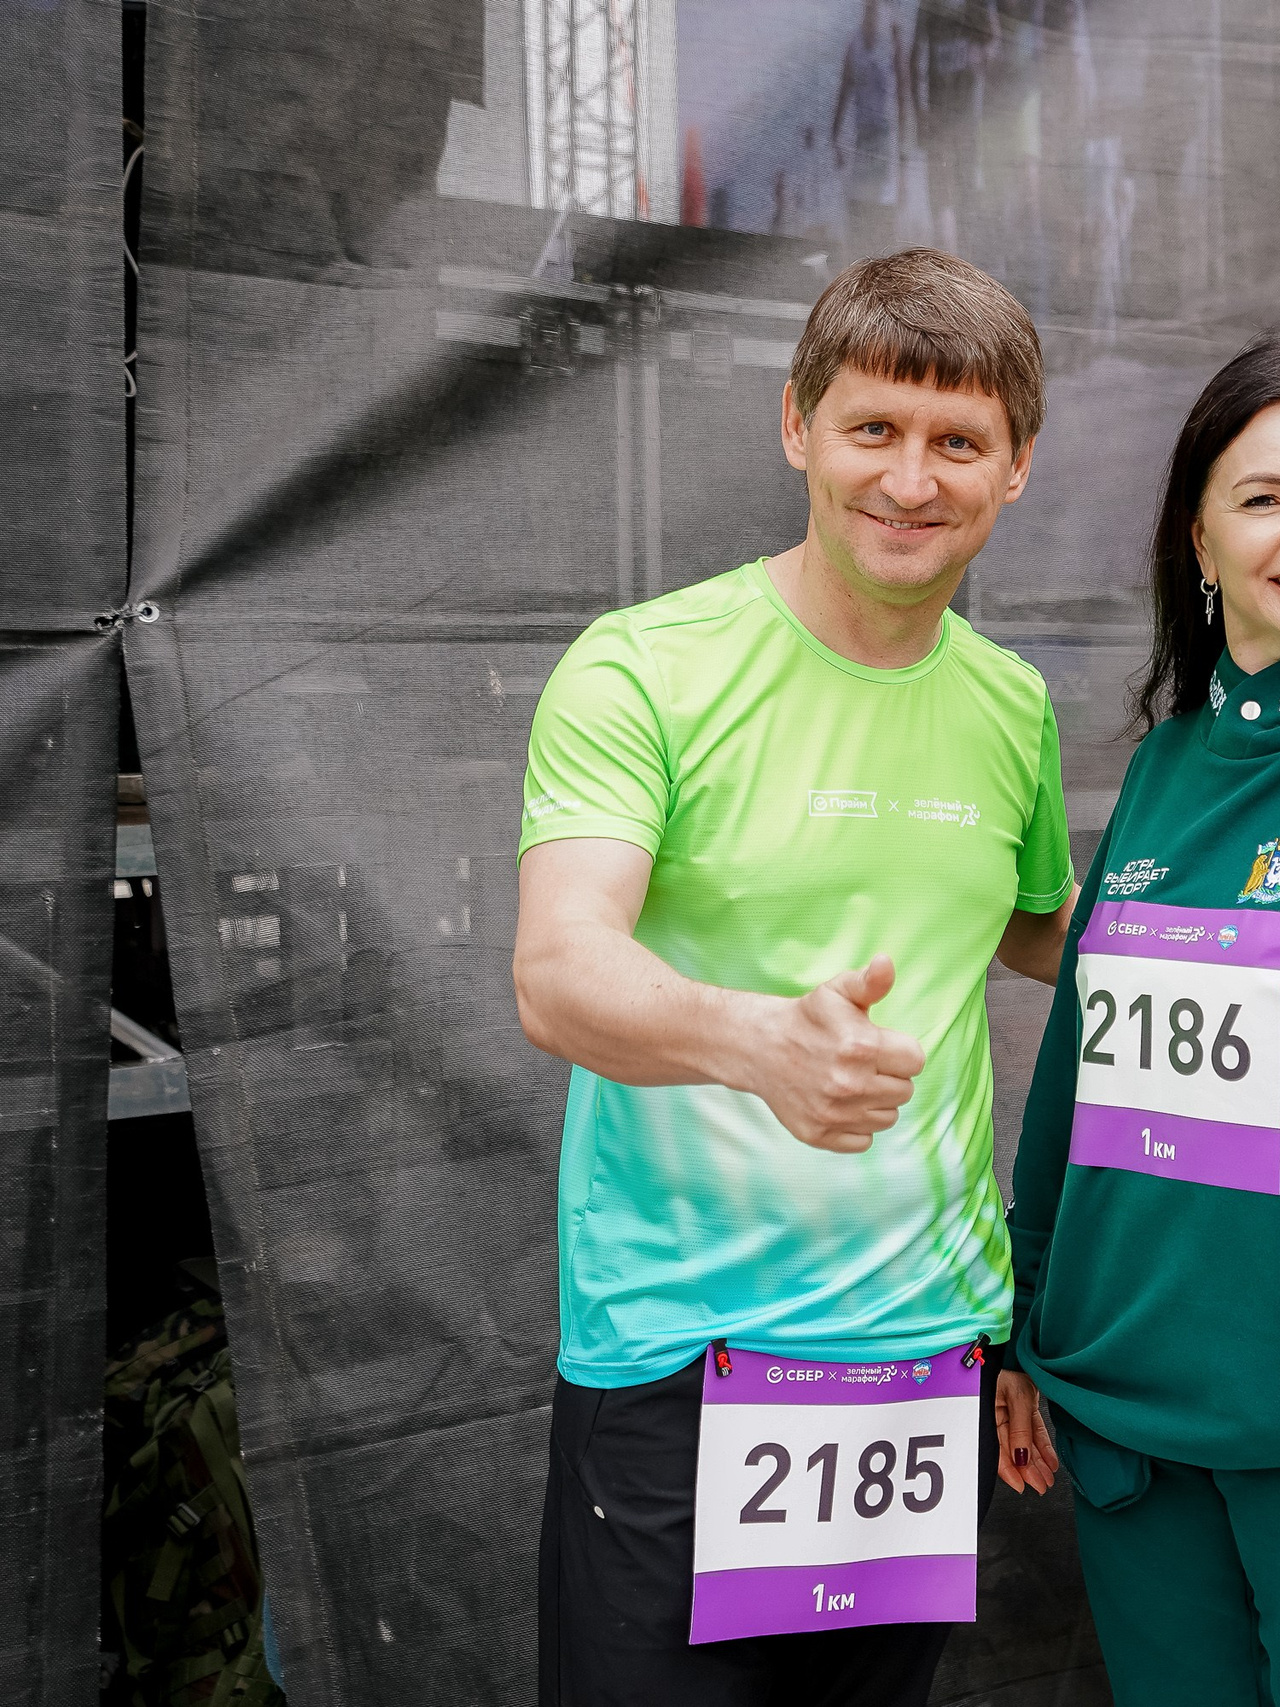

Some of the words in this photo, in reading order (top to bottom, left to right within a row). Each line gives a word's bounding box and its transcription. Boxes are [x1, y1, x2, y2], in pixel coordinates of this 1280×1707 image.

[829, 797, 868, 810] Прайм
[913, 797, 962, 812] зелёный
[907, 808, 960, 823] марафон
[1123, 858, 1156, 872] ЮГРА
[1103, 867, 1170, 884] ВЫБИРАЕТ
[1107, 881, 1151, 895] СПОРТ
[1118, 923, 1147, 936] СБЕР
[1159, 933, 1188, 942] марафон
[1082, 989, 1252, 1082] 2186
[786, 1369, 824, 1382] СБЕР
[846, 1366, 882, 1375] зелёный
[841, 1375, 878, 1384] марафон
[739, 1434, 945, 1524] 2185
